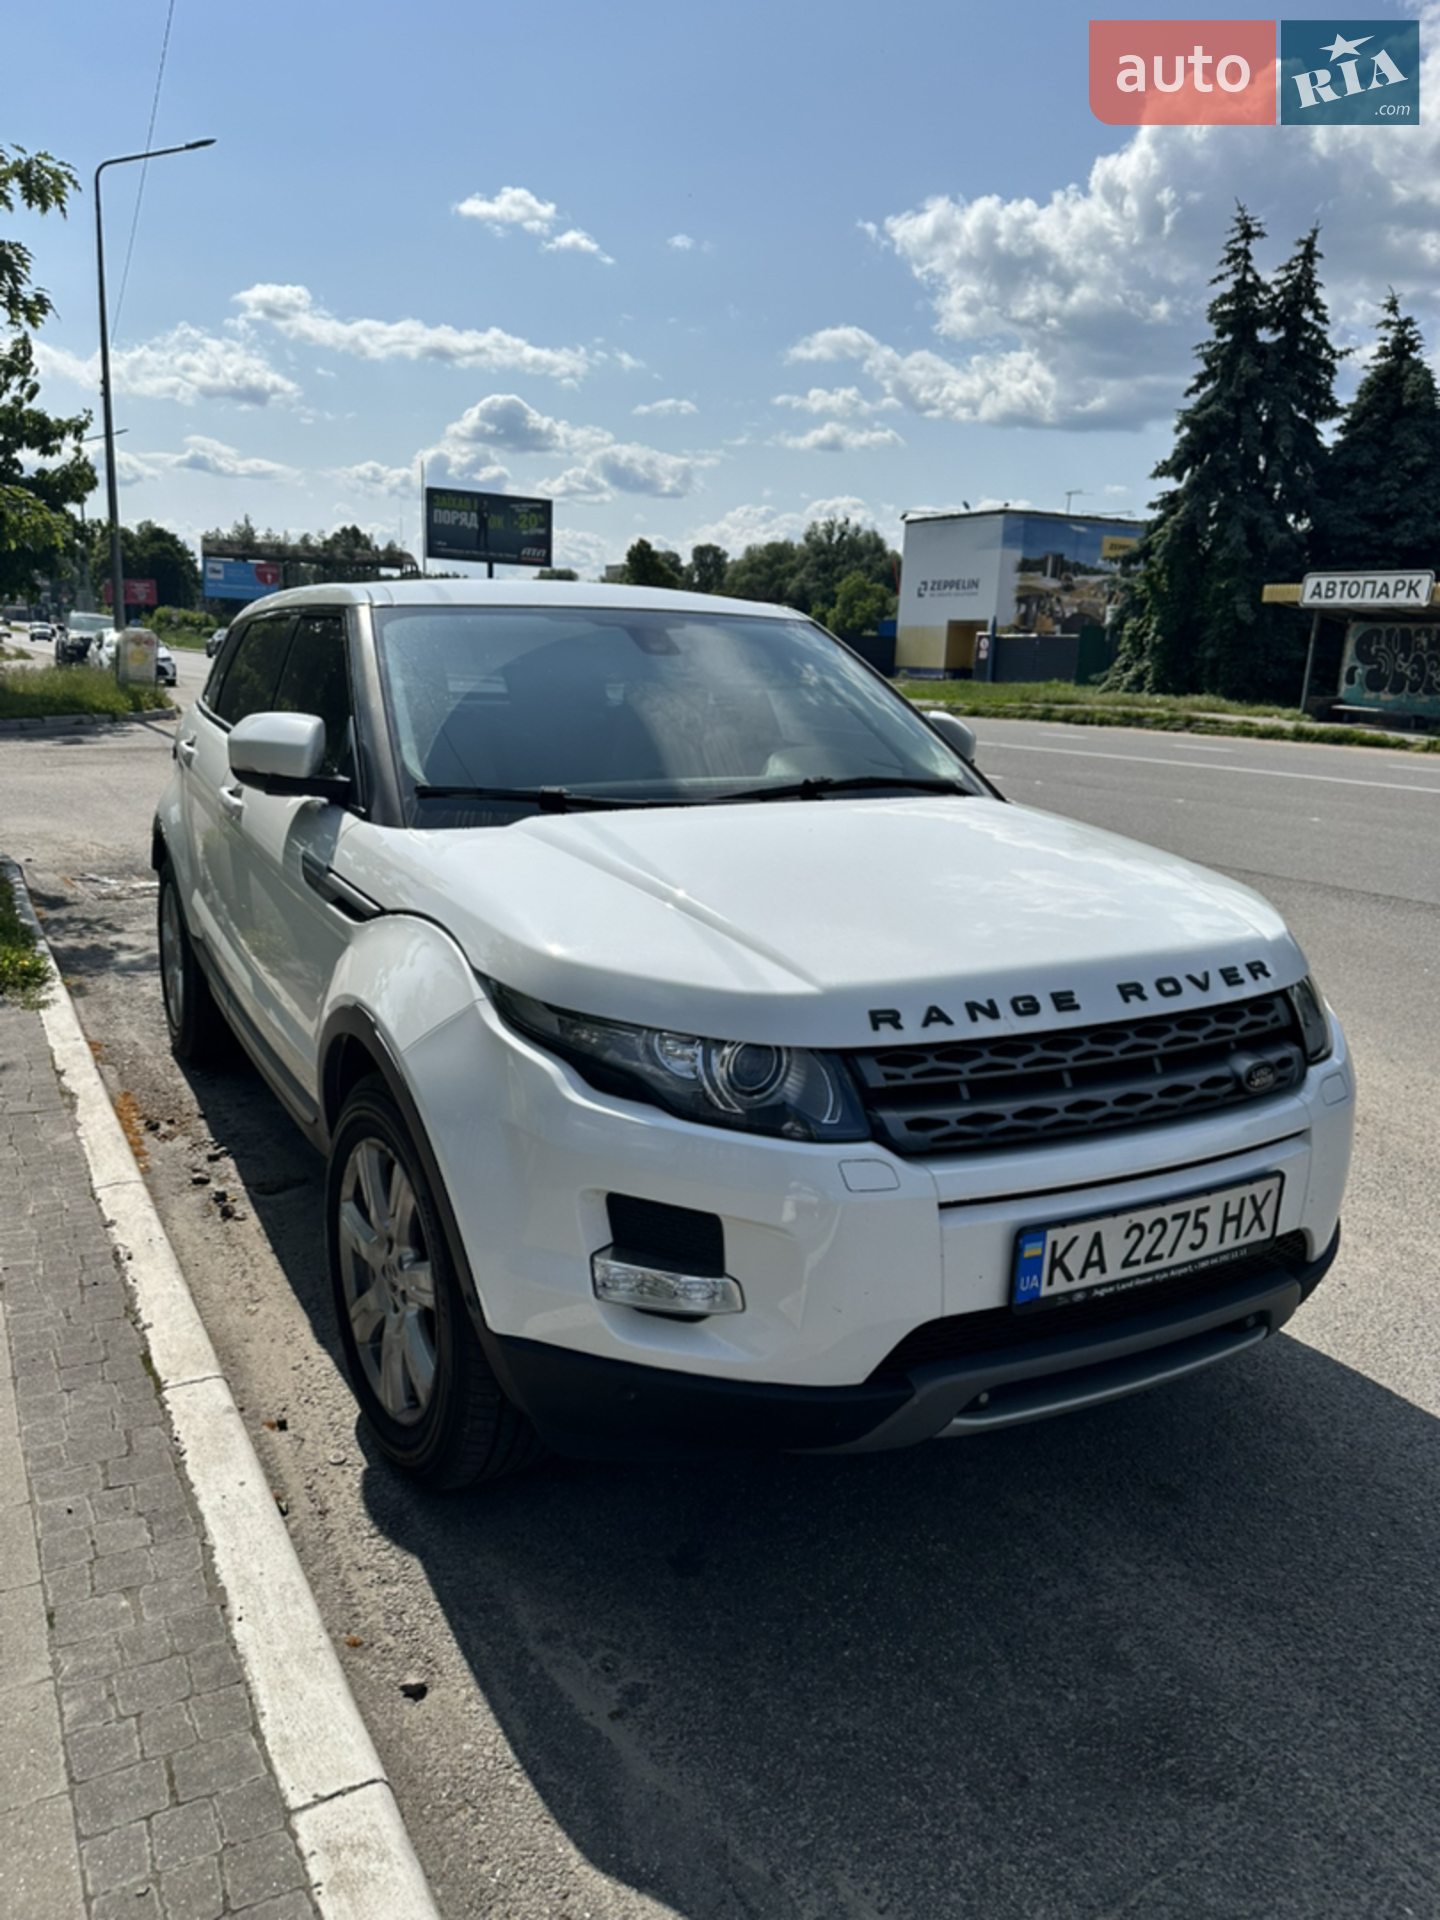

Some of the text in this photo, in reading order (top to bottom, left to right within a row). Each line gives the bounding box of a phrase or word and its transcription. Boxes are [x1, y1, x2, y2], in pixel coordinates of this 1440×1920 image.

[929, 578, 980, 591] ZEPPELIN
[1310, 579, 1422, 600] АВТОПАРК
[867, 959, 1272, 1032] RANGE ROVER
[1046, 1188, 1274, 1287] KA 2275 HX
[1020, 1274, 1039, 1292] UA
